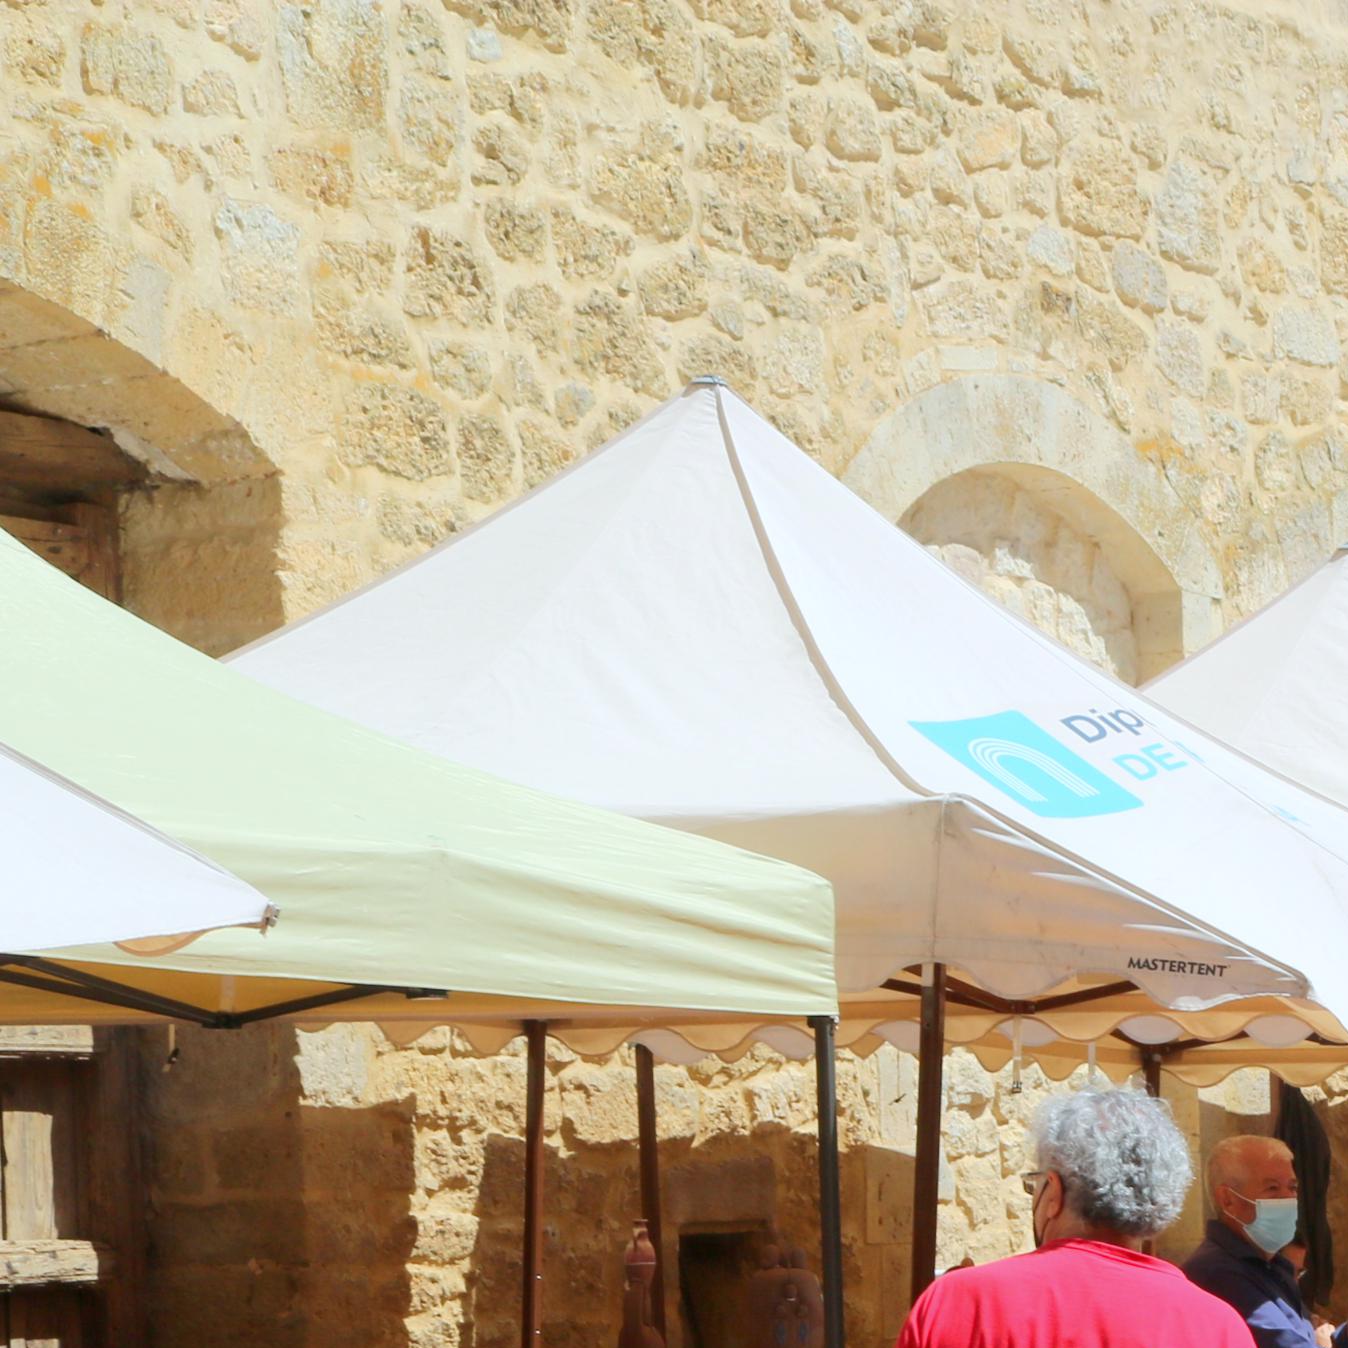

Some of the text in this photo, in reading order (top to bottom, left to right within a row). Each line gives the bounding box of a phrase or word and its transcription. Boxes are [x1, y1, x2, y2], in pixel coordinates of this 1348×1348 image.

[1059, 707, 1145, 744] Dip
[1112, 743, 1189, 781] DE
[1128, 956, 1228, 977] MASTERTENT
